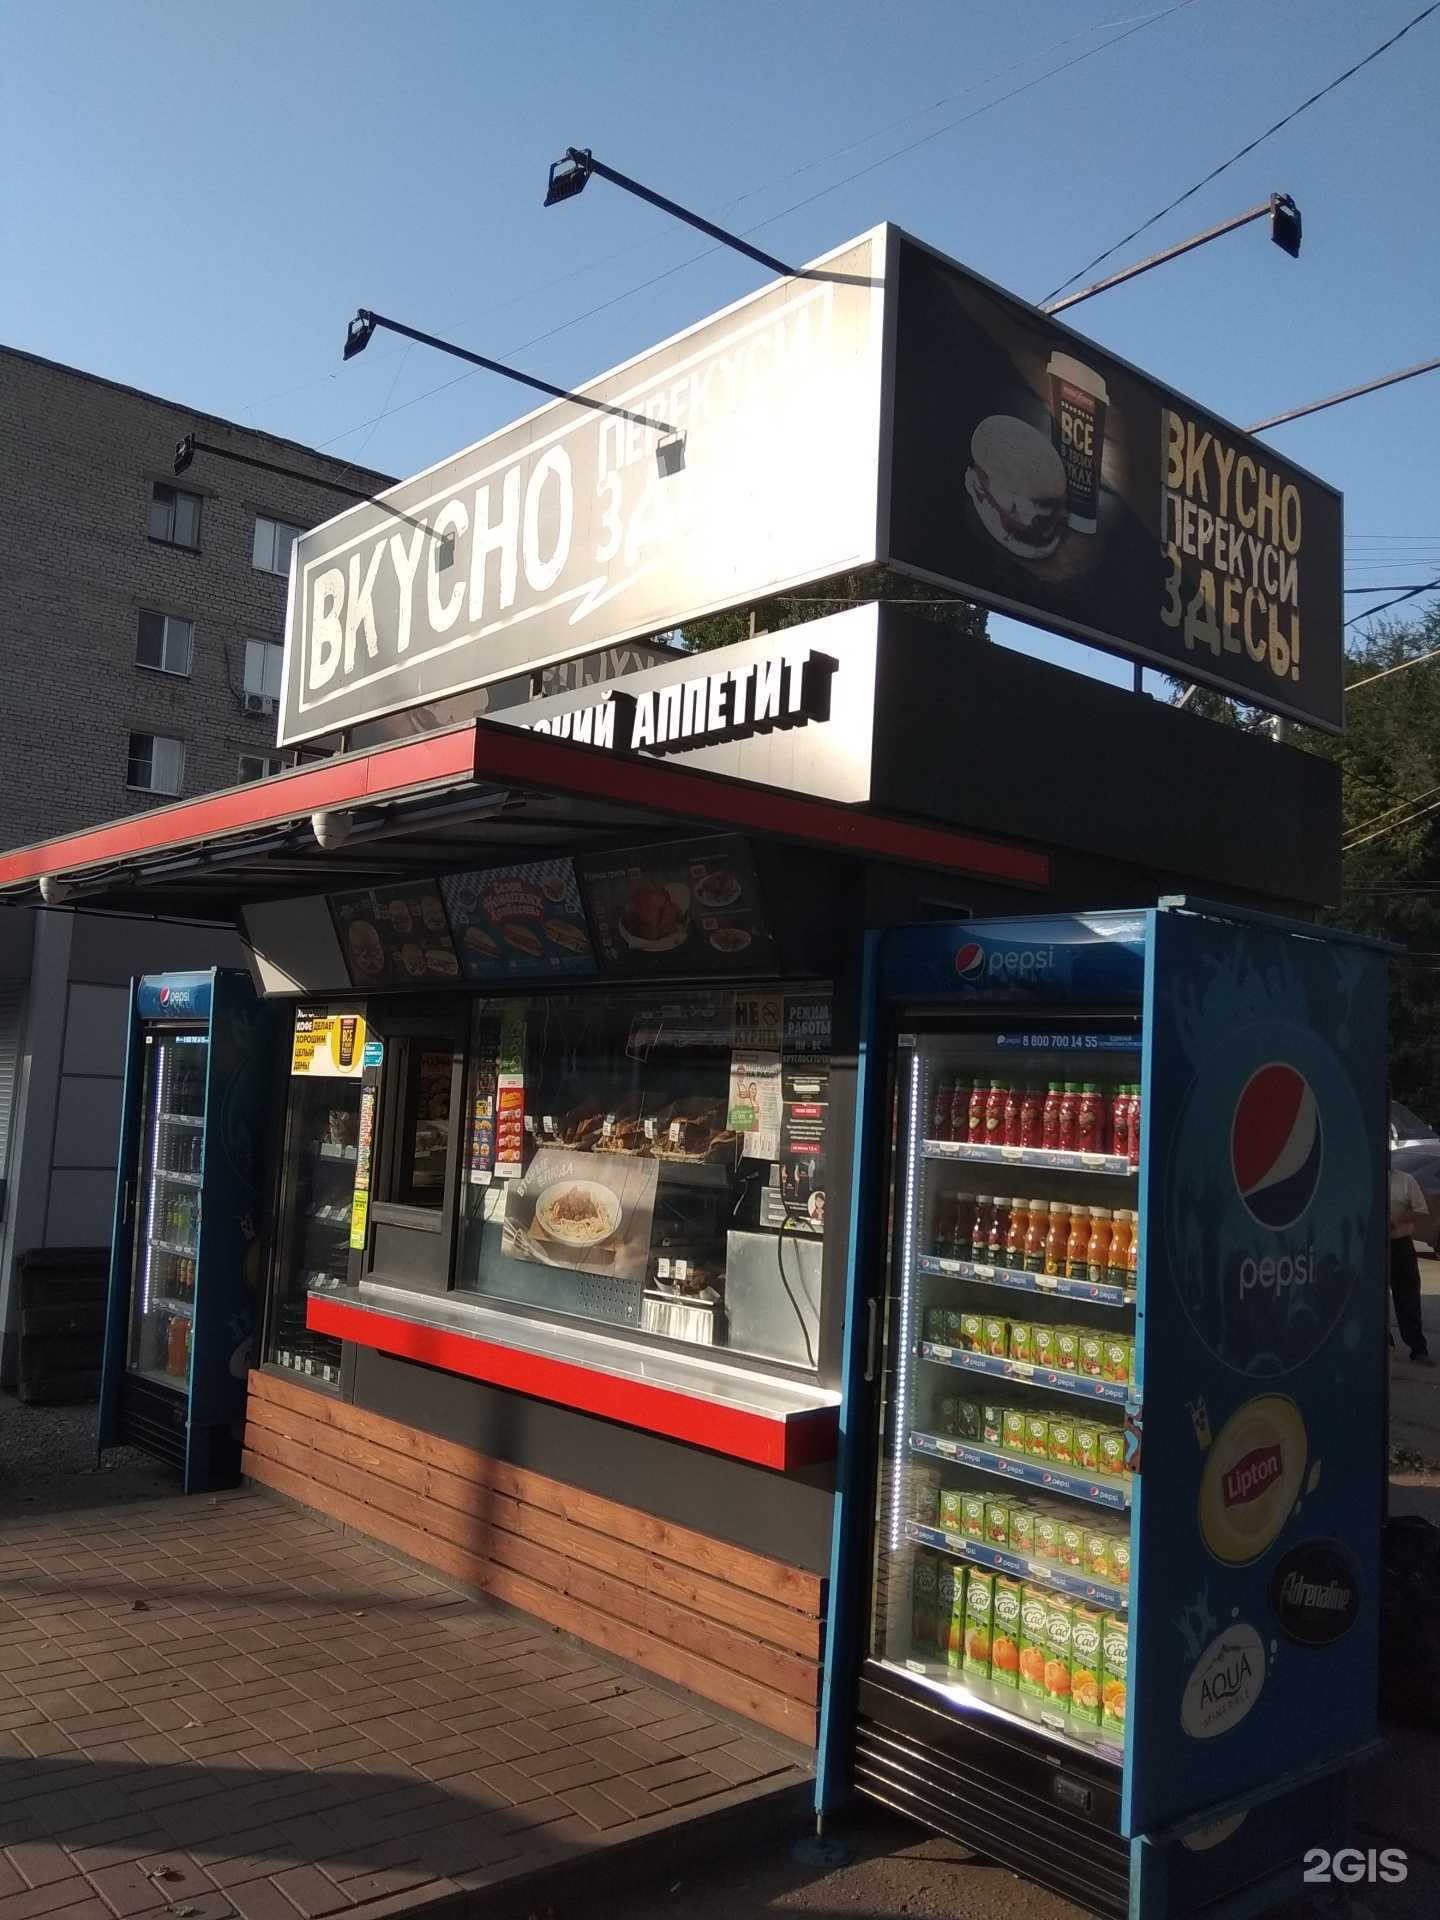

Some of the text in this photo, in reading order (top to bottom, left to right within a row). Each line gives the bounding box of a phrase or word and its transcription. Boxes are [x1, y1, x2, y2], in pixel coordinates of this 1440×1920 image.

[1060, 410, 1094, 456] ВСЕ
[1161, 408, 1300, 554] ВКУСНО
[1161, 493, 1298, 607] ПЕРЕКУСИ
[310, 445, 573, 690] ВКУСНО
[1161, 543, 1299, 681] ЗДЕСЬ!
[631, 653, 811, 749] АППЕТИТ
[988, 946, 1055, 975] pepsi
[169, 989, 190, 1002] pepsi
[790, 1005, 829, 1020] РЕЖИМ
[296, 1021, 312, 1032] КОФЕ
[788, 1020, 831, 1037] РАБОТЫ
[295, 1046, 315, 1057] ЦЕЛЫЙ
[1022, 1035, 1029, 1047] 8
[1031, 1035, 1049, 1047] 800
[1051, 1035, 1069, 1047] 700
[1071, 1036, 1082, 1047] 14
[1085, 1036, 1098, 1048] 55
[1240, 1245, 1316, 1300] pepsi
[1057, 1377, 1075, 1388] pepsi
[1105, 1388, 1123, 1399] pepsi
[964, 1452, 981, 1463] pepsi
[1006, 1466, 1024, 1476] pepsi
[1051, 1478, 1070, 1489] pepsi
[1099, 1491, 1119, 1502] pepsi
[1227, 1455, 1279, 1498] Lipton
[997, 1600, 1019, 1616] Сад
[1023, 1609, 1046, 1626] Сад
[1048, 1622, 1070, 1638] Сад
[1075, 1633, 1098, 1648] Сад
[1200, 1652, 1252, 1709] AQUA
